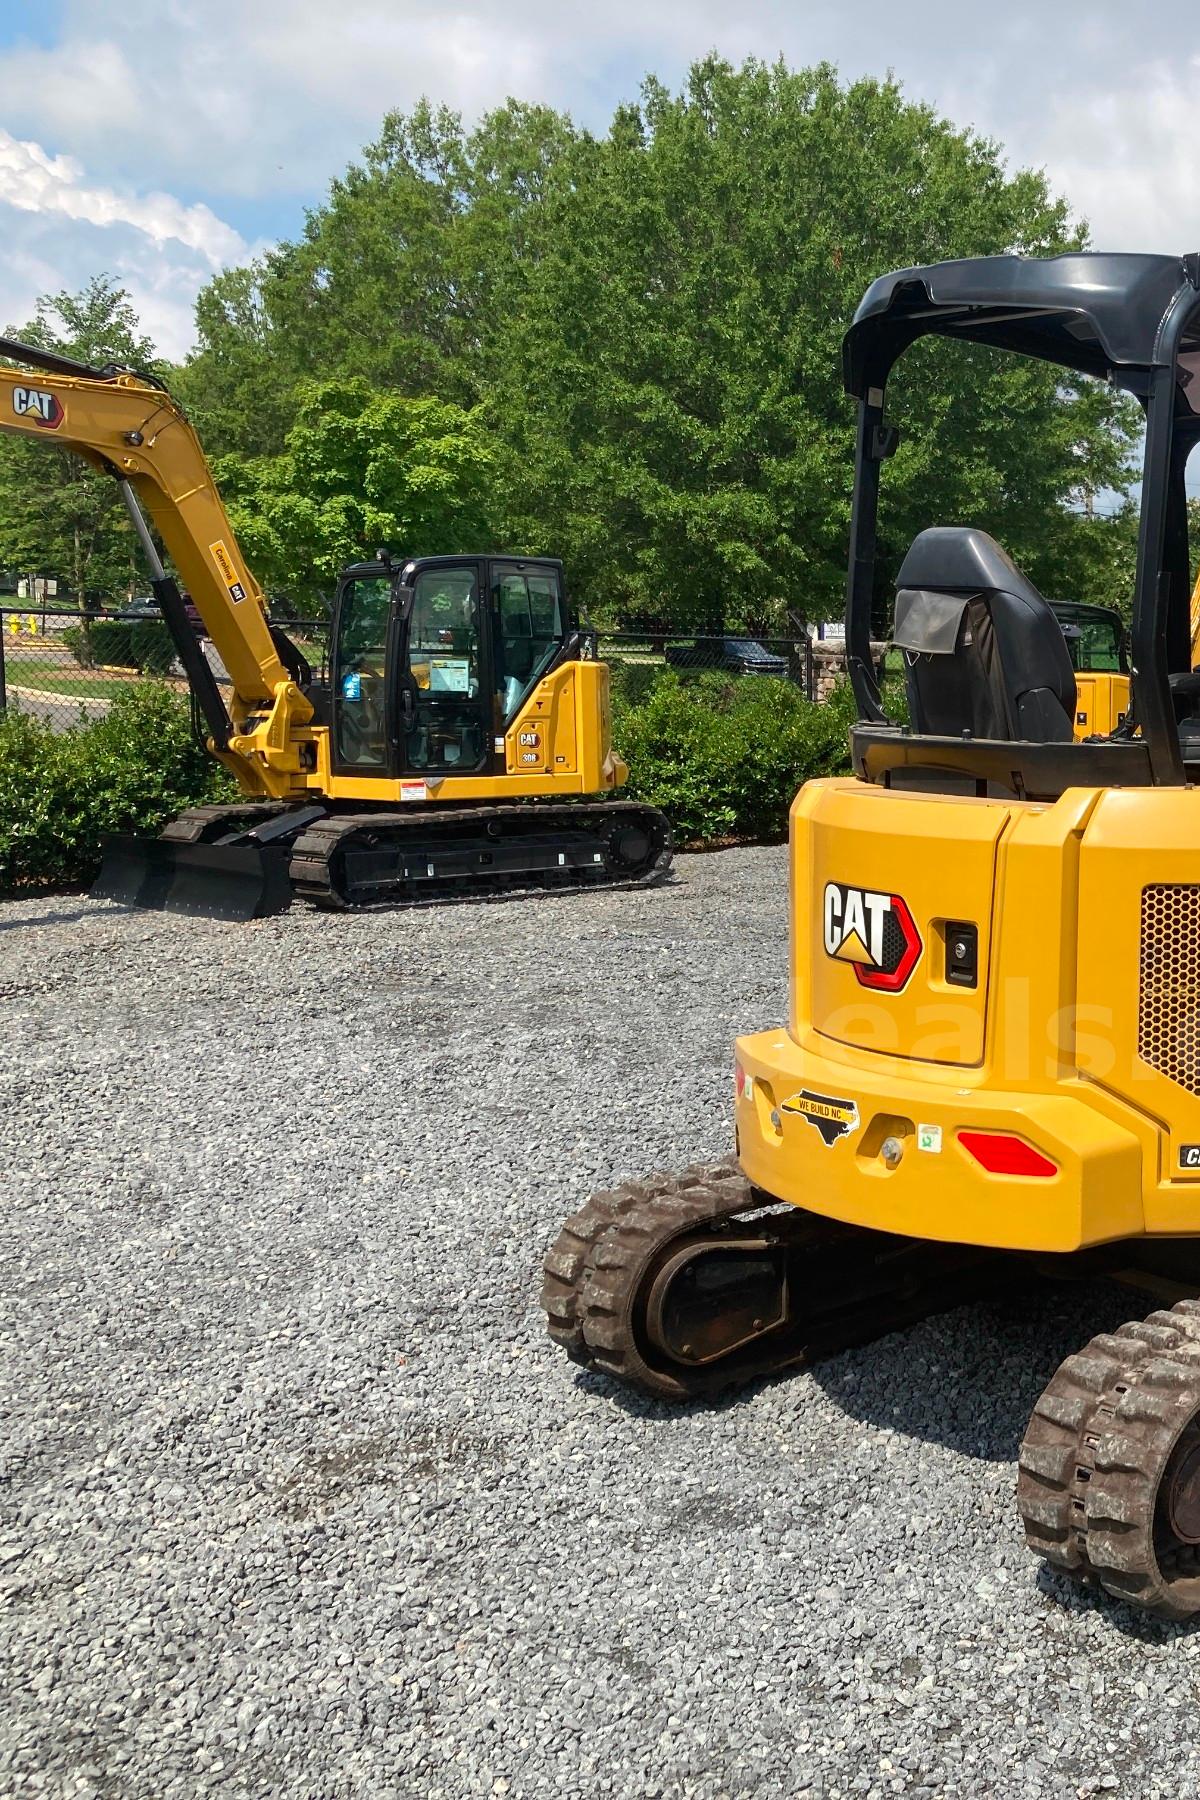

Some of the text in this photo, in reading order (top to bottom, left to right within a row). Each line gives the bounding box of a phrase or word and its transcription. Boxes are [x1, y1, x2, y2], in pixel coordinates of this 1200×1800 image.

[13, 387, 52, 420] CAT
[231, 585, 243, 600] CAT
[520, 733, 537, 746] CAT
[825, 883, 891, 967] CAT
[800, 1099, 842, 1120] WE BUILD NC
